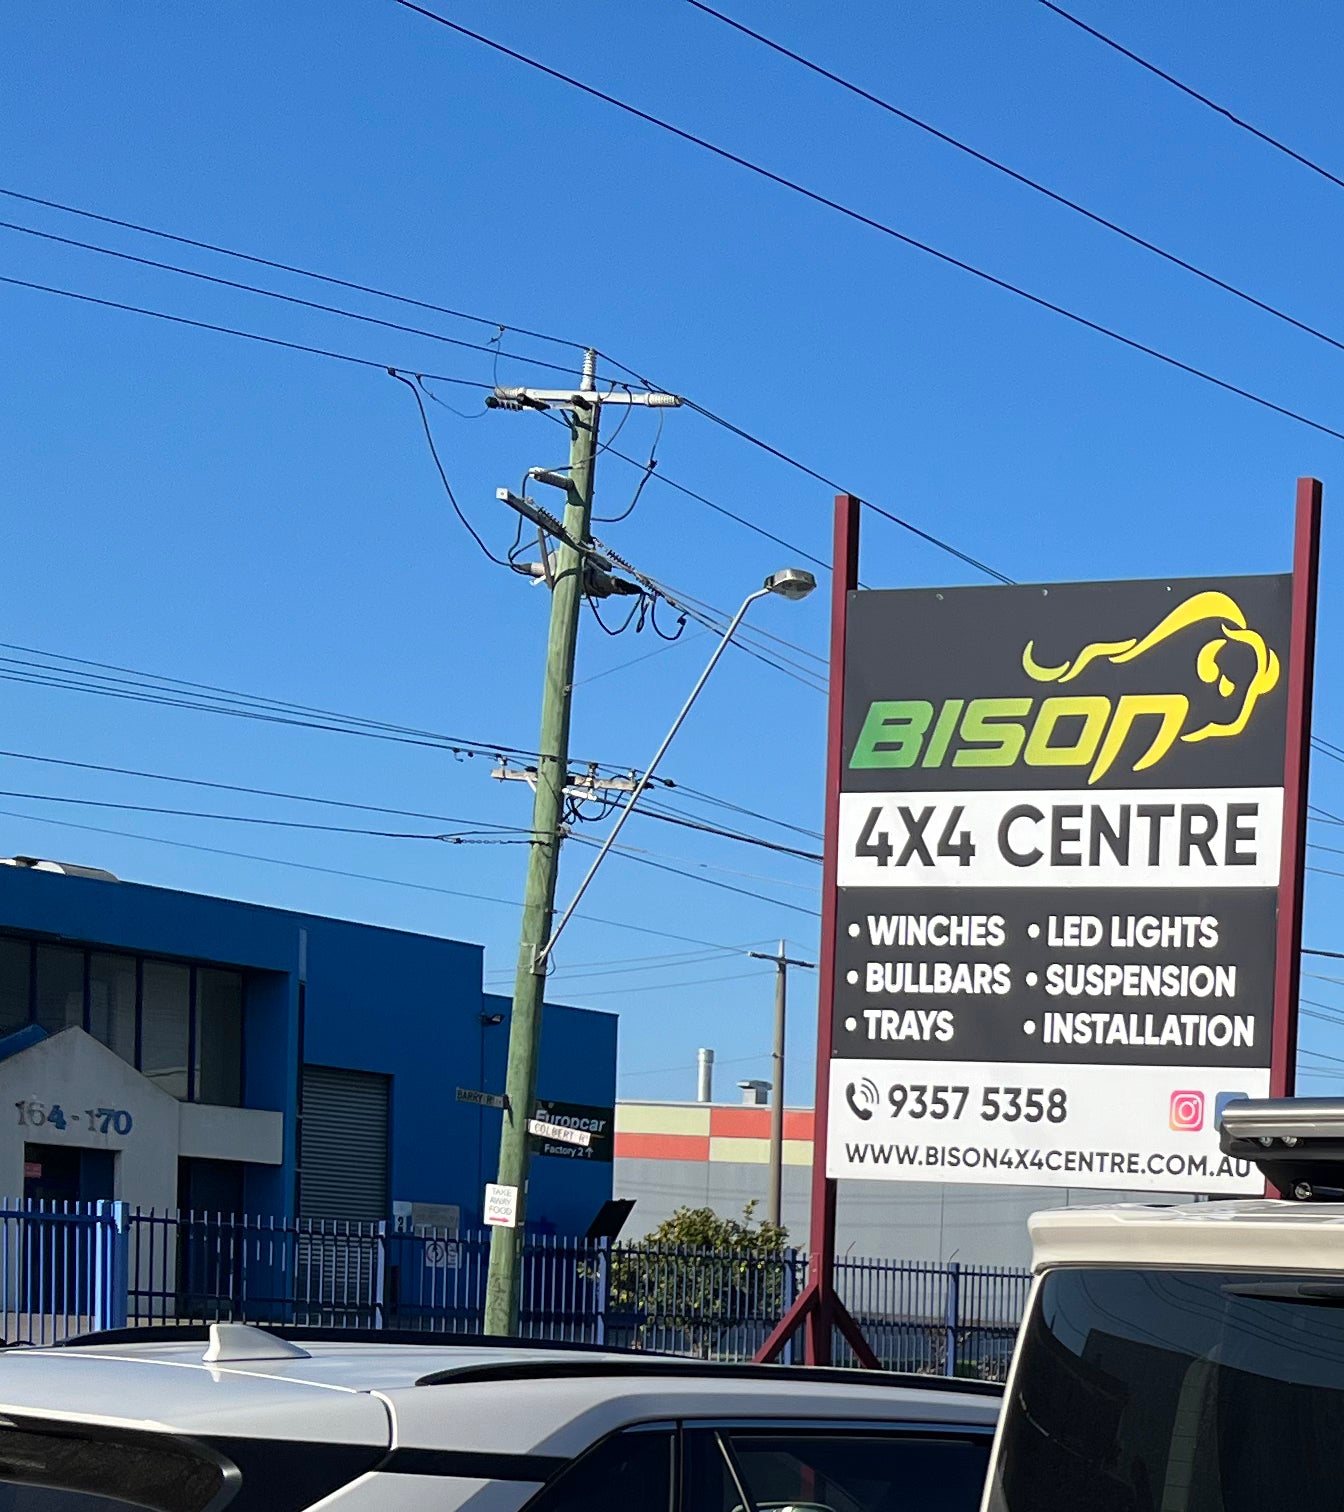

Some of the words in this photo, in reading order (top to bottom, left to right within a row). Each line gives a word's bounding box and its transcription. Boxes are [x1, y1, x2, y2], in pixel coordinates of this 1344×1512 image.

[855, 806, 976, 867] 4X4
[998, 803, 1259, 867] CENTRE
[867, 916, 1005, 947] WINCHES
[1047, 916, 1103, 948] LED
[1111, 916, 1219, 949] LIGHTS
[865, 963, 1011, 994] BULLBARS
[1045, 964, 1236, 998] SUSPENSION
[863, 1010, 954, 1041] TRAYS
[1043, 1012, 1255, 1047] INSTALLATION
[888, 1084, 969, 1120] 9357
[981, 1087, 1067, 1124] 5358
[534, 1122, 574, 1140] COLBERT
[544, 1143, 577, 1157] Factory
[577, 1147, 584, 1157] 2
[845, 1143, 1251, 1178] WWW.BISON4X4CENTRE.COM.AU
[491, 1187, 512, 1197] TAKE
[488, 1205, 513, 1216] FOOD
